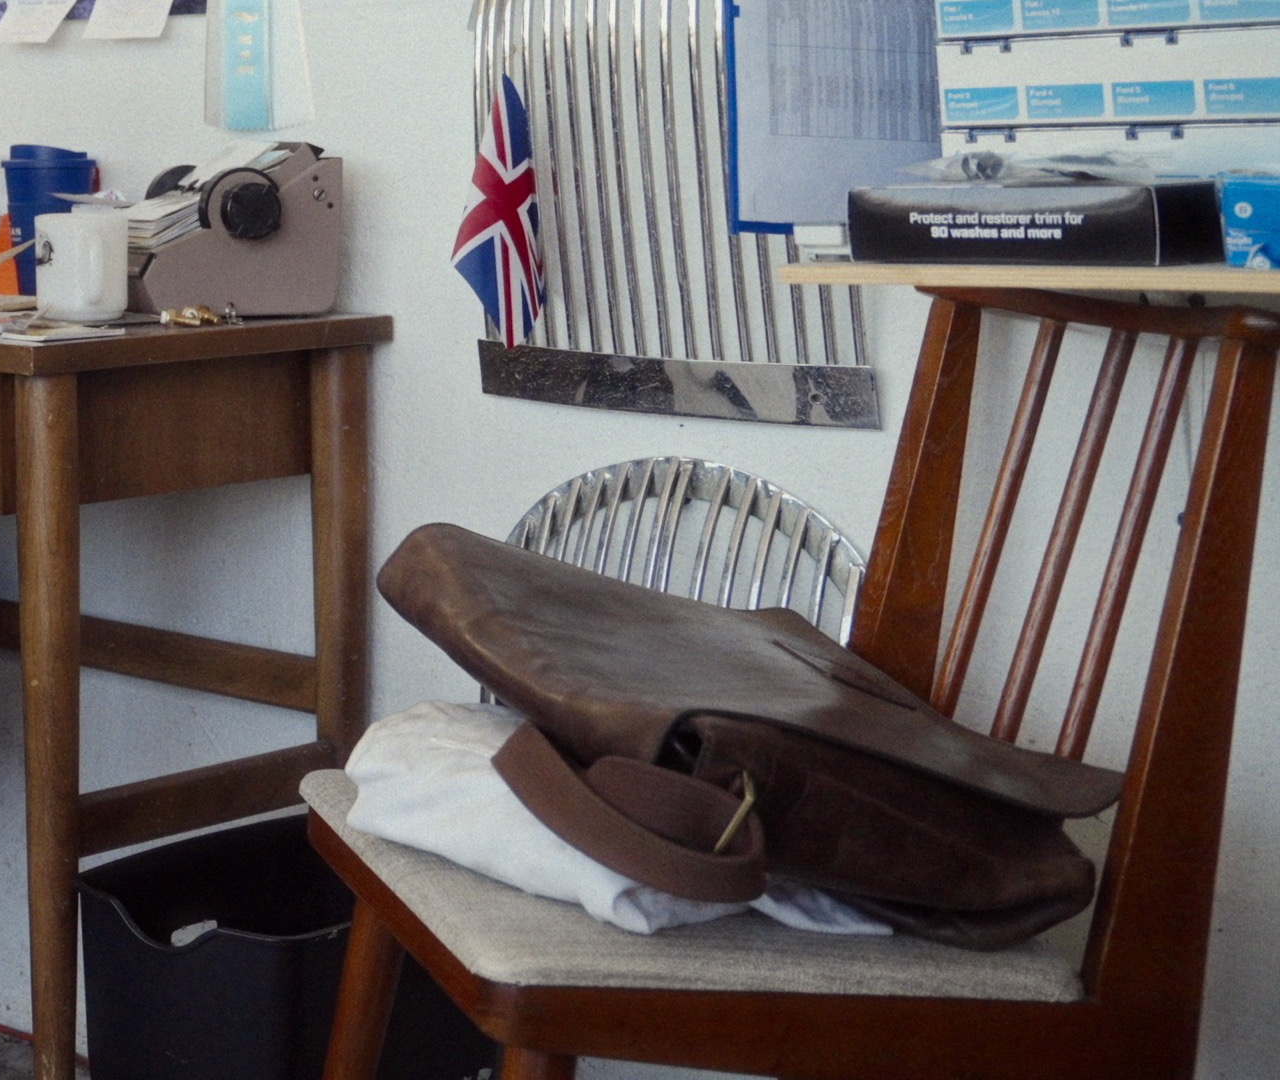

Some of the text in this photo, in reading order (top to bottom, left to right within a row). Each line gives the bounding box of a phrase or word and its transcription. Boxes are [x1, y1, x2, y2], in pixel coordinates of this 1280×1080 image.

[909, 212, 1084, 225] Protect and restorer trim for
[930, 226, 1062, 239] 90 washes and more
